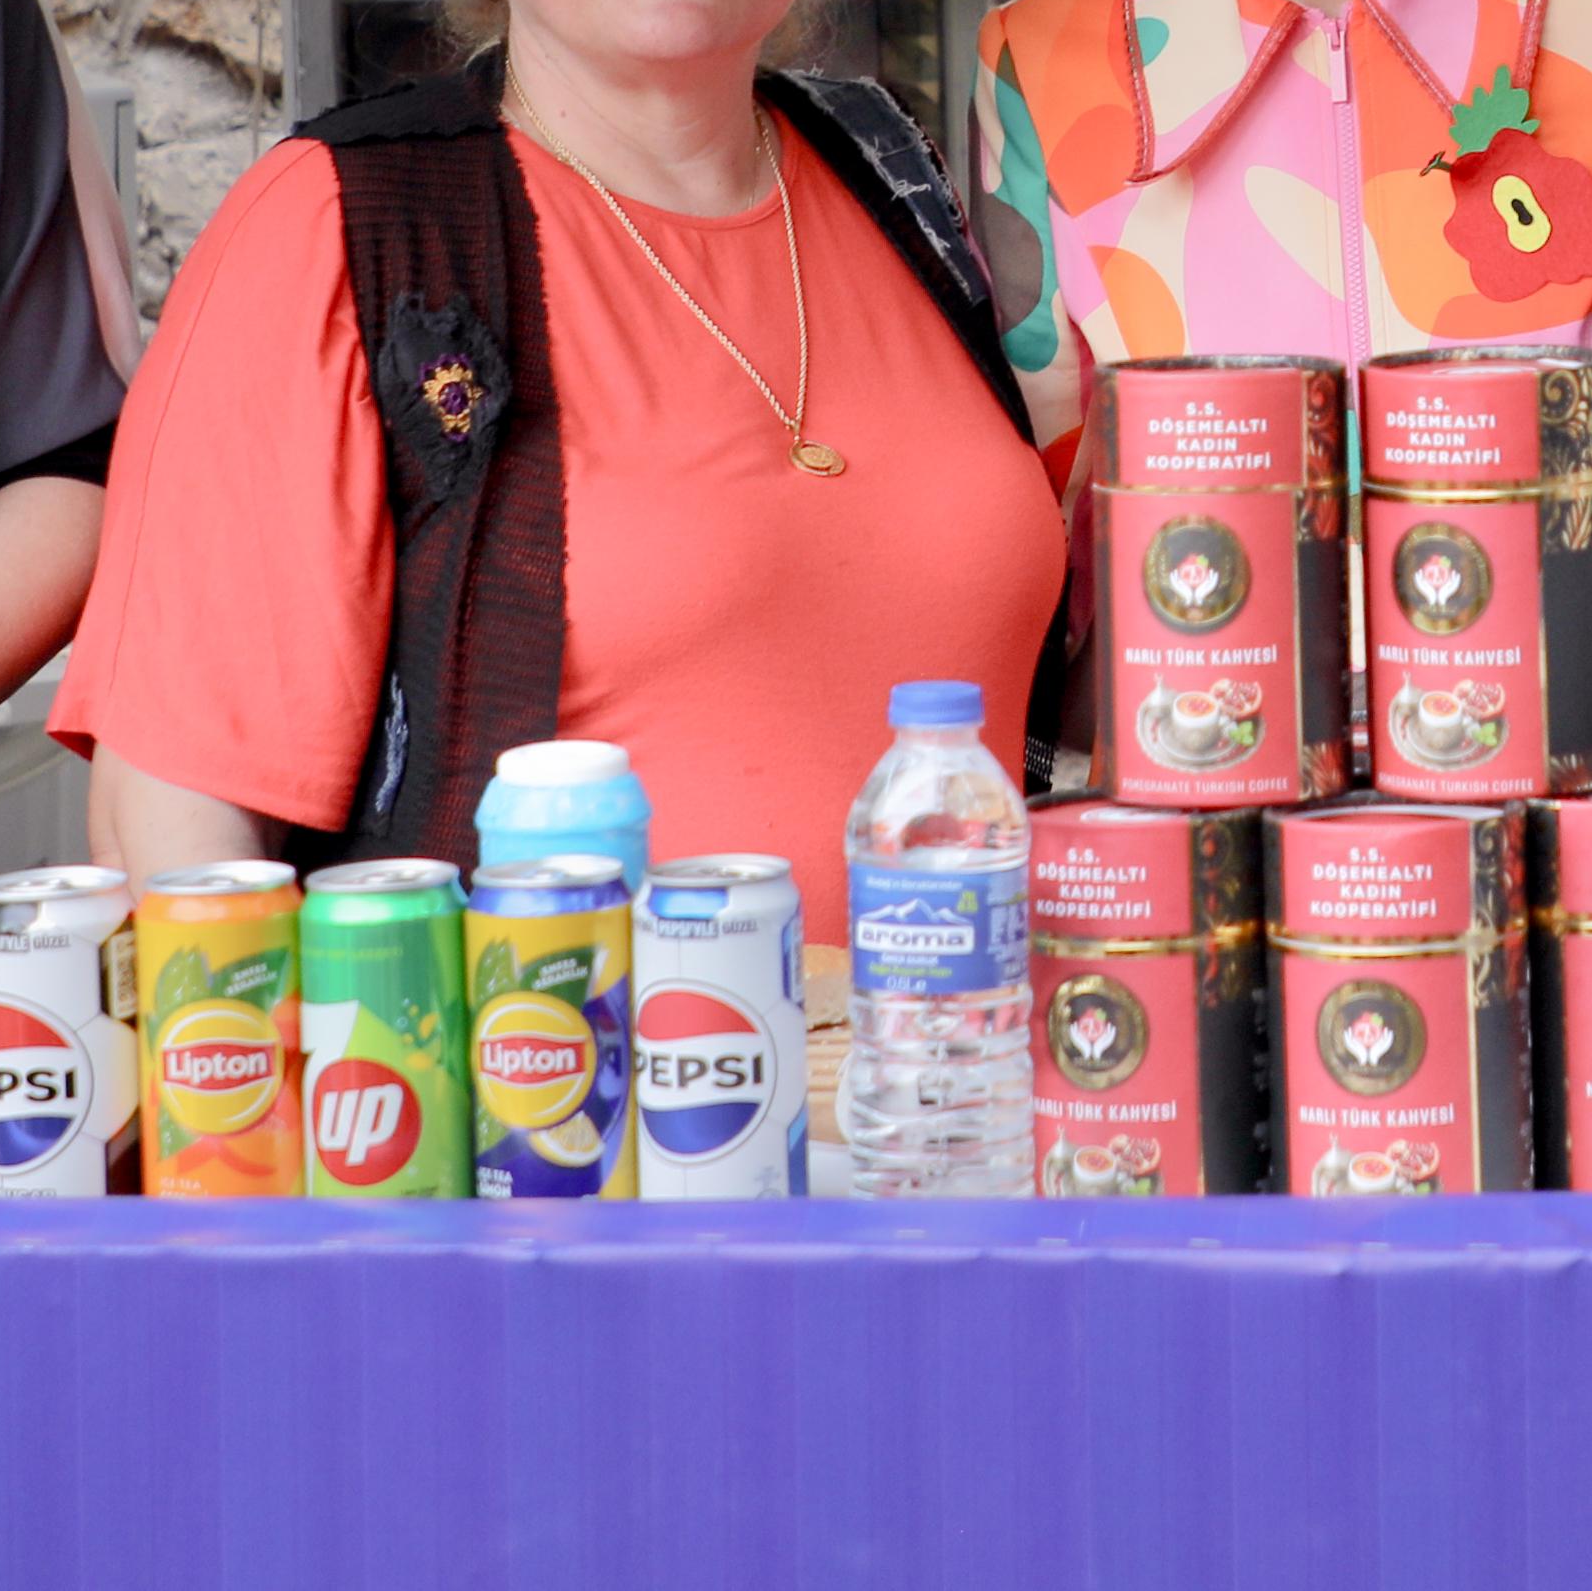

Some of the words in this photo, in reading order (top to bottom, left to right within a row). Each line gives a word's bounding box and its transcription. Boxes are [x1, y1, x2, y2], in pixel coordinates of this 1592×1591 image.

[1148, 418, 1267, 434] DÖŞEMEALTI
[1386, 411, 1496, 428] DÖŞEMEALTI
[1176, 438, 1237, 452] KADIN
[1409, 432, 1466, 446] KADIN
[1146, 453, 1271, 470] KOOPERATİFİ
[1385, 447, 1501, 464] KOOPERATİFİ
[1166, 647, 1205, 665] TÜRK
[1210, 644, 1277, 665] KAHVESİ
[1413, 647, 1449, 665] TÜRK
[1454, 646, 1521, 666] KAHVESİ
[1312, 861, 1433, 882] DÖŞEMEALTI
[1060, 883, 1116, 899] KADIN
[1339, 883, 1402, 899] KADIN
[1310, 898, 1437, 918] KOOPERATİFİ
[862, 927, 965, 947] aroma
[167, 1051, 267, 1084] Lipton
[483, 1042, 577, 1076] Lipton
[1067, 1100, 1104, 1121] TÜRK
[1109, 1099, 1177, 1122] KAHVESİ
[1300, 1105, 1336, 1126] NARLI
[1342, 1107, 1382, 1128] TÜRK
[1386, 1102, 1454, 1128] KAHVESİ
